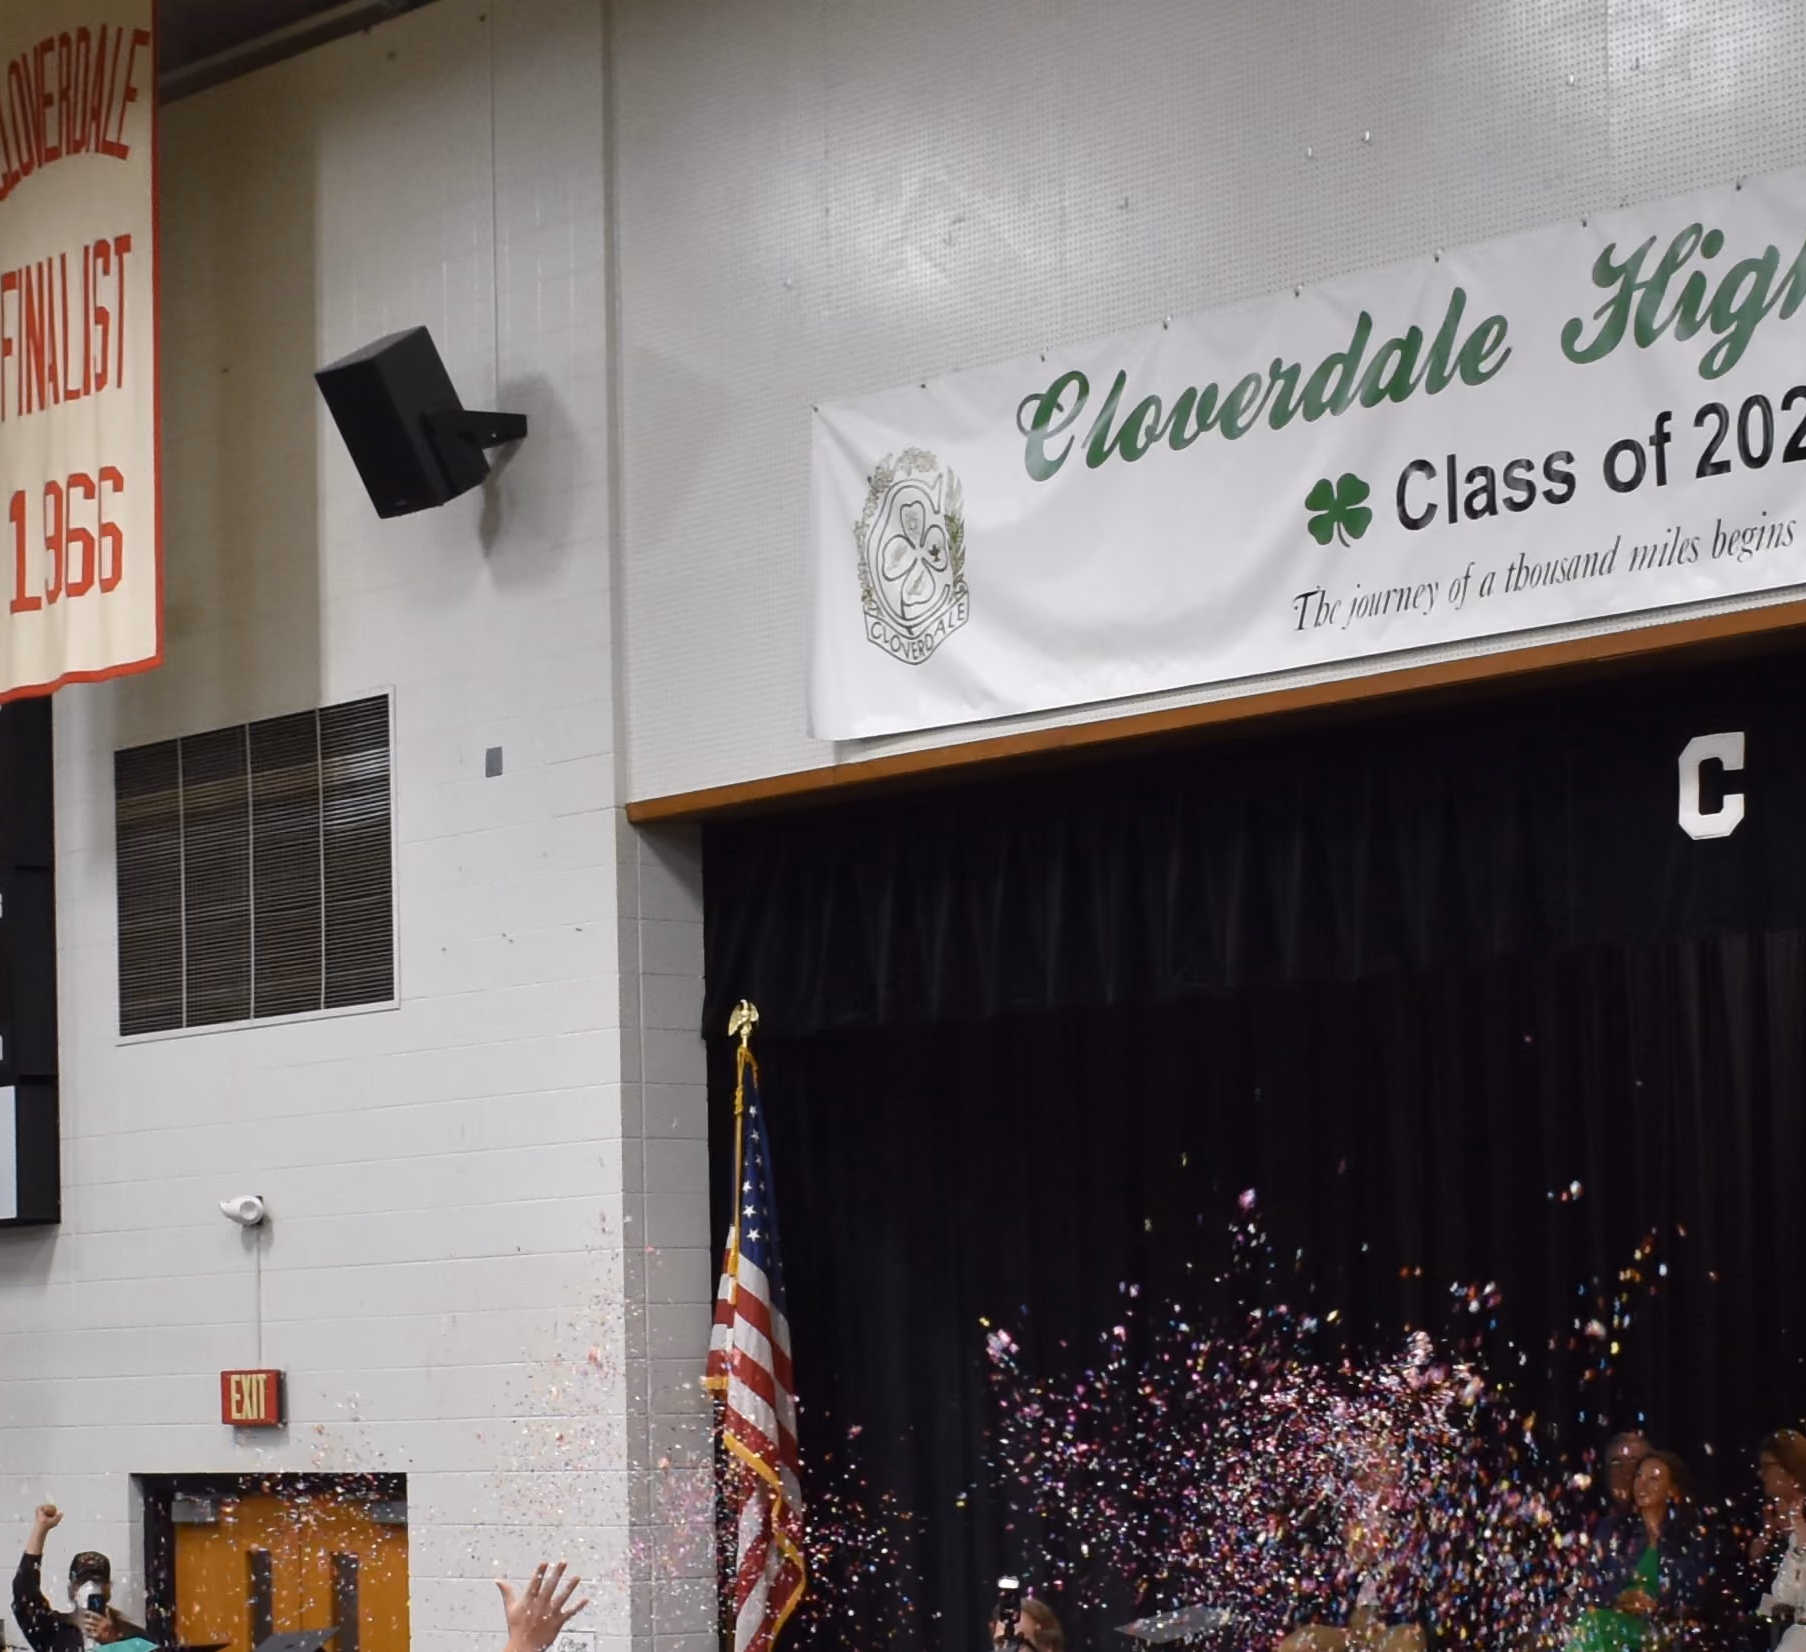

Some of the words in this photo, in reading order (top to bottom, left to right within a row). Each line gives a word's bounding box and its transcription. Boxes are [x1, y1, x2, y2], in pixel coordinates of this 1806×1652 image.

[0, 233, 132, 423] FINALIST
[1016, 286, 1513, 483] Cloverdale
[1395, 450, 1577, 531] Class
[1602, 411, 1673, 493] of
[9, 465, 125, 615] 1966
[1293, 585, 1342, 631] The
[1341, 580, 1439, 630] journey
[1448, 561, 1476, 611] of
[1479, 571, 1497, 599] a
[1504, 535, 1622, 594] thousand
[1628, 526, 1700, 572] miles
[1711, 511, 1797, 563] begins
[870, 601, 966, 661] CLOVERDALE
[1678, 731, 1745, 841] C
[230, 1373, 267, 1420] EXIT
